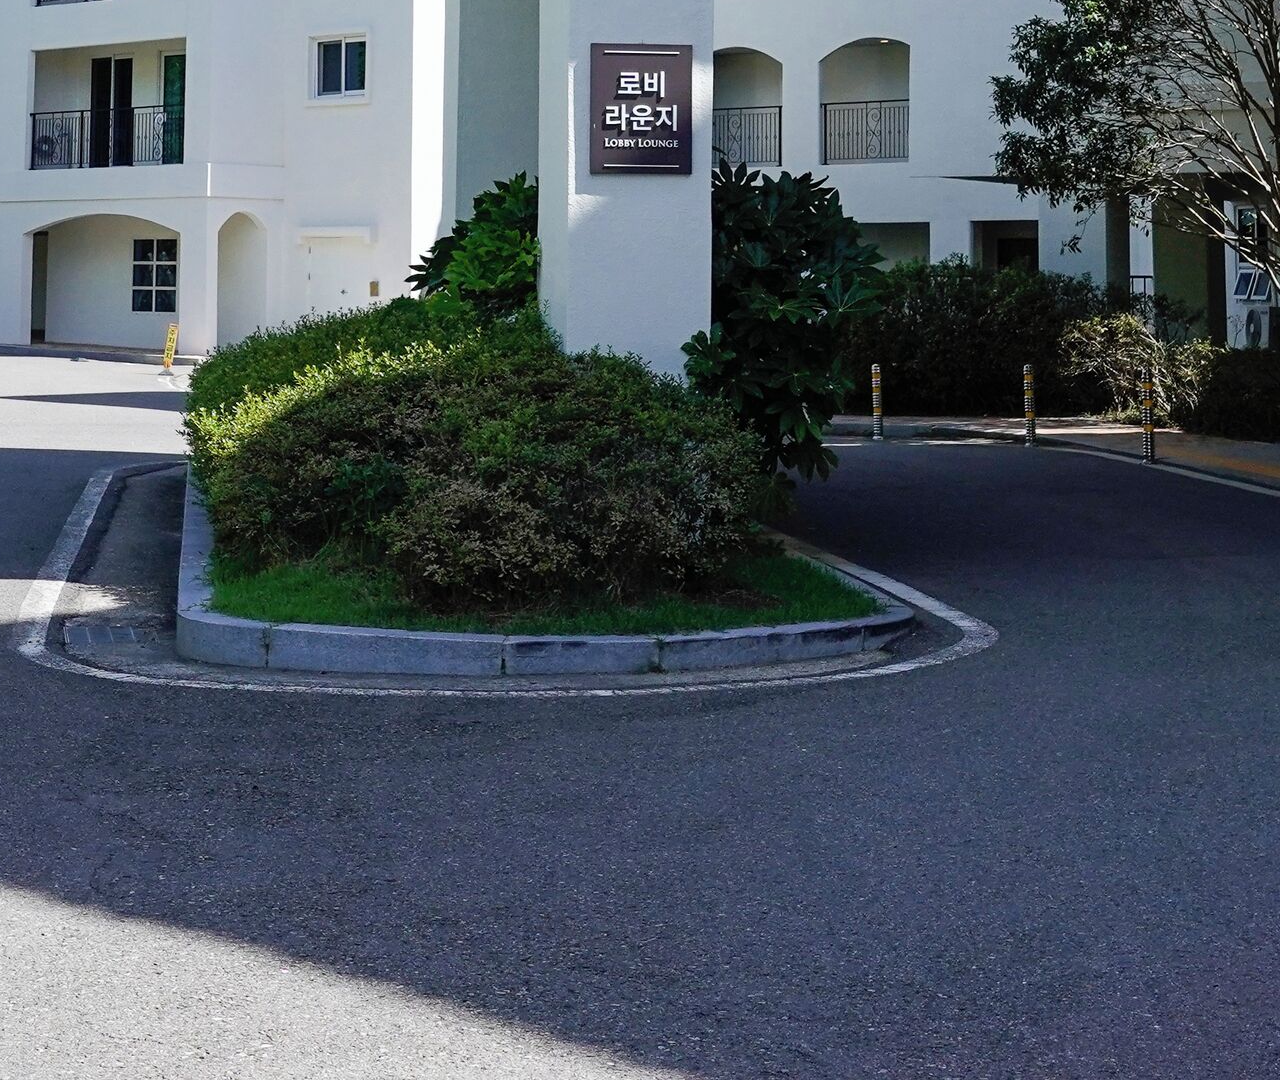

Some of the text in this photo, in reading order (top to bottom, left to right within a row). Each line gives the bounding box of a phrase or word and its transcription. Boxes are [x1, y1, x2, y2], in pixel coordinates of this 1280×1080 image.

[617, 70, 666, 98] 로비
[605, 103, 678, 132] 라운지
[604, 137, 679, 148] LOBBY LOUNGE
